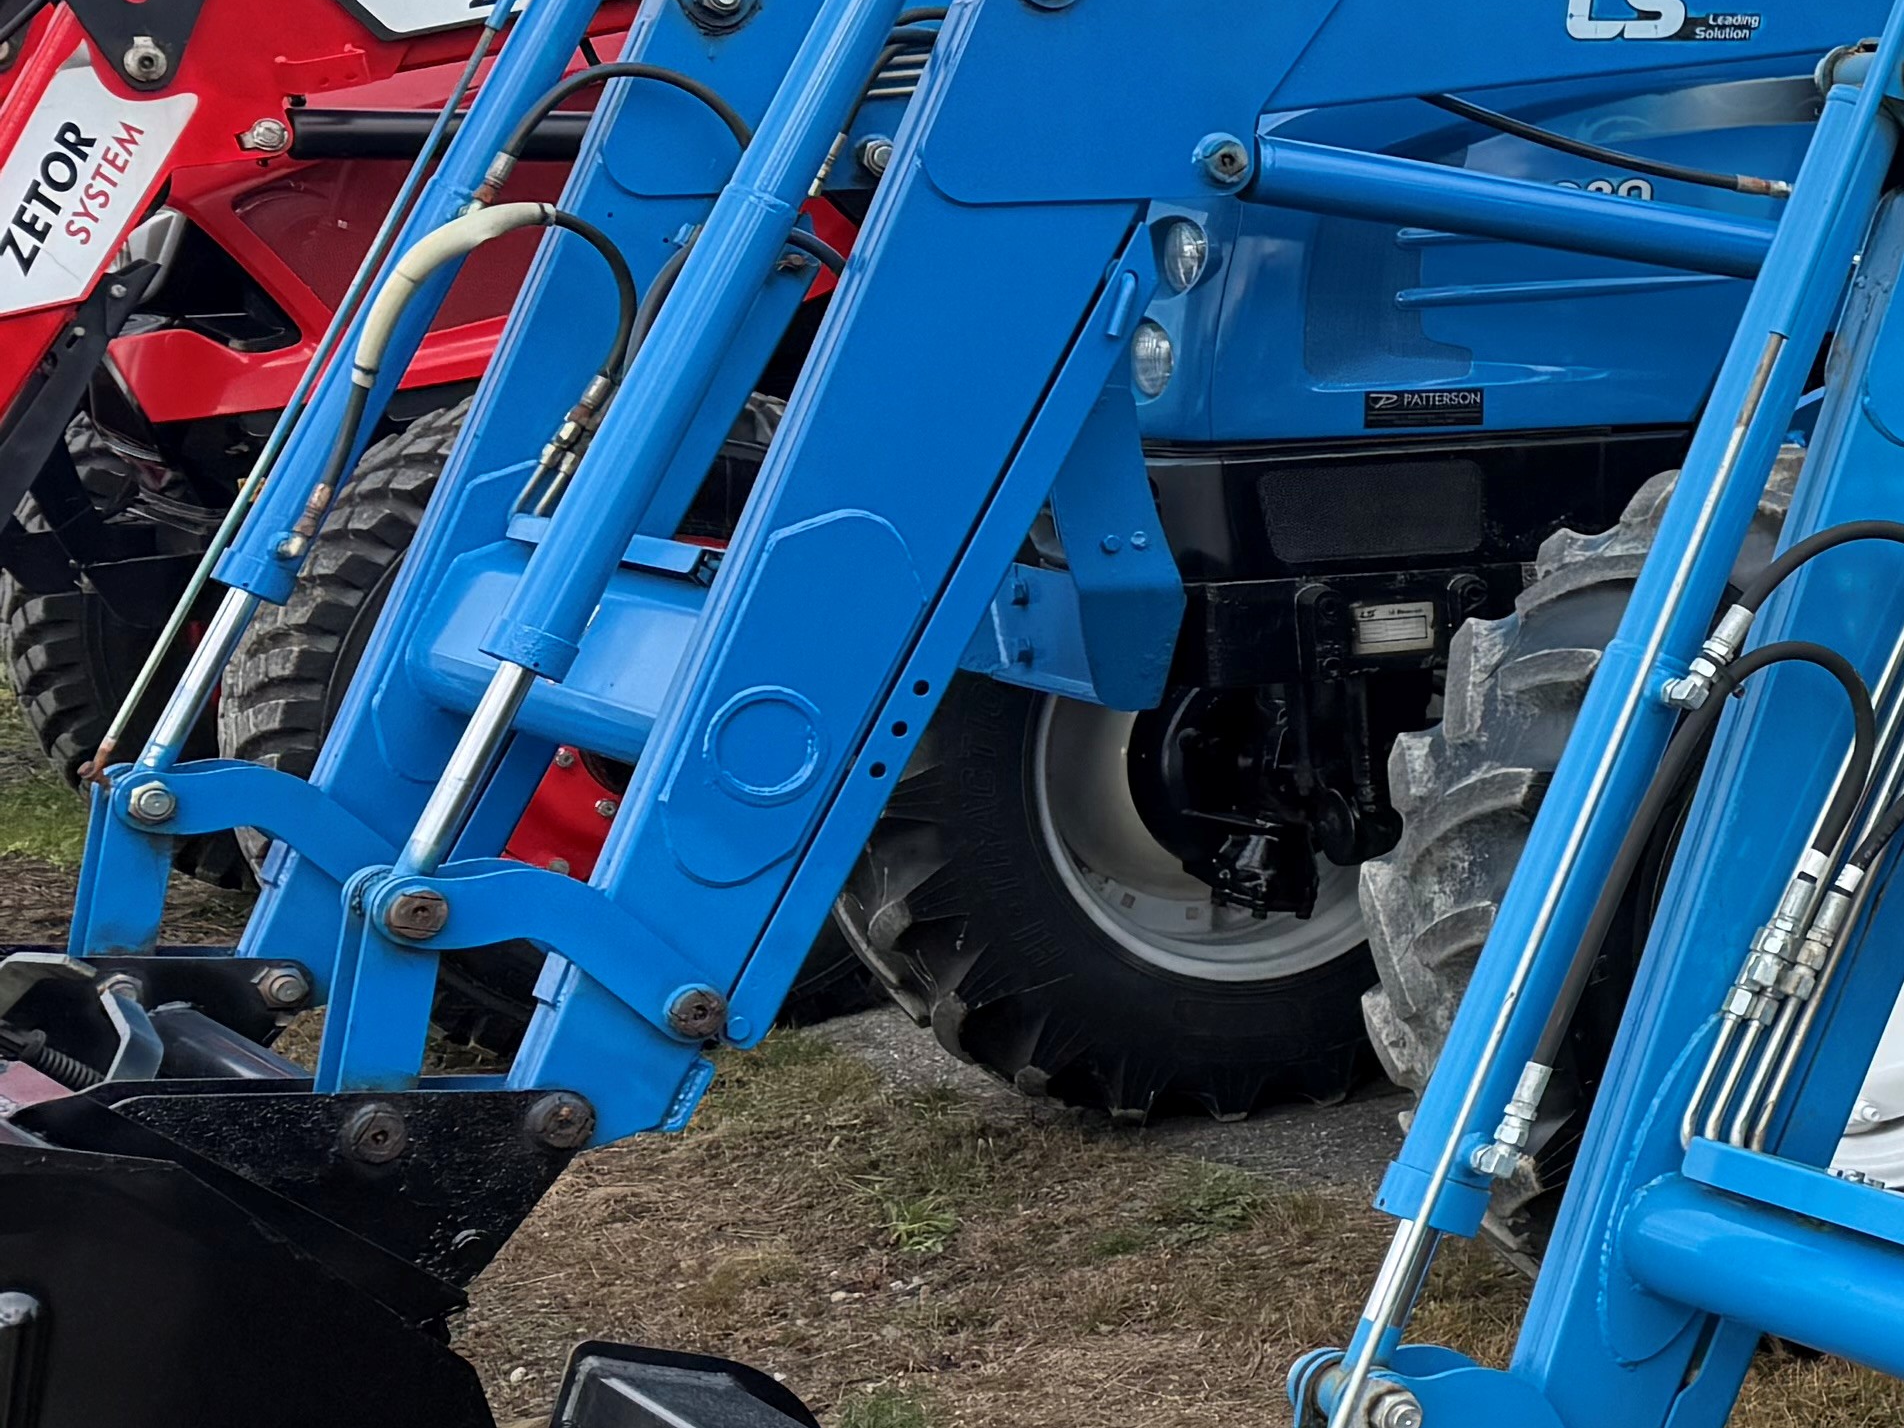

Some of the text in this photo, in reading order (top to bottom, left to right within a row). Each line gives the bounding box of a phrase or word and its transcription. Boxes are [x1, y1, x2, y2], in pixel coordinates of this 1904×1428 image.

[1708, 13, 1761, 28] Leading
[1695, 26, 1751, 40] Solution
[65, 121, 145, 245] SYSTEM
[0, 121, 97, 277] ZETOR
[1403, 391, 1481, 407] PATTERSON
